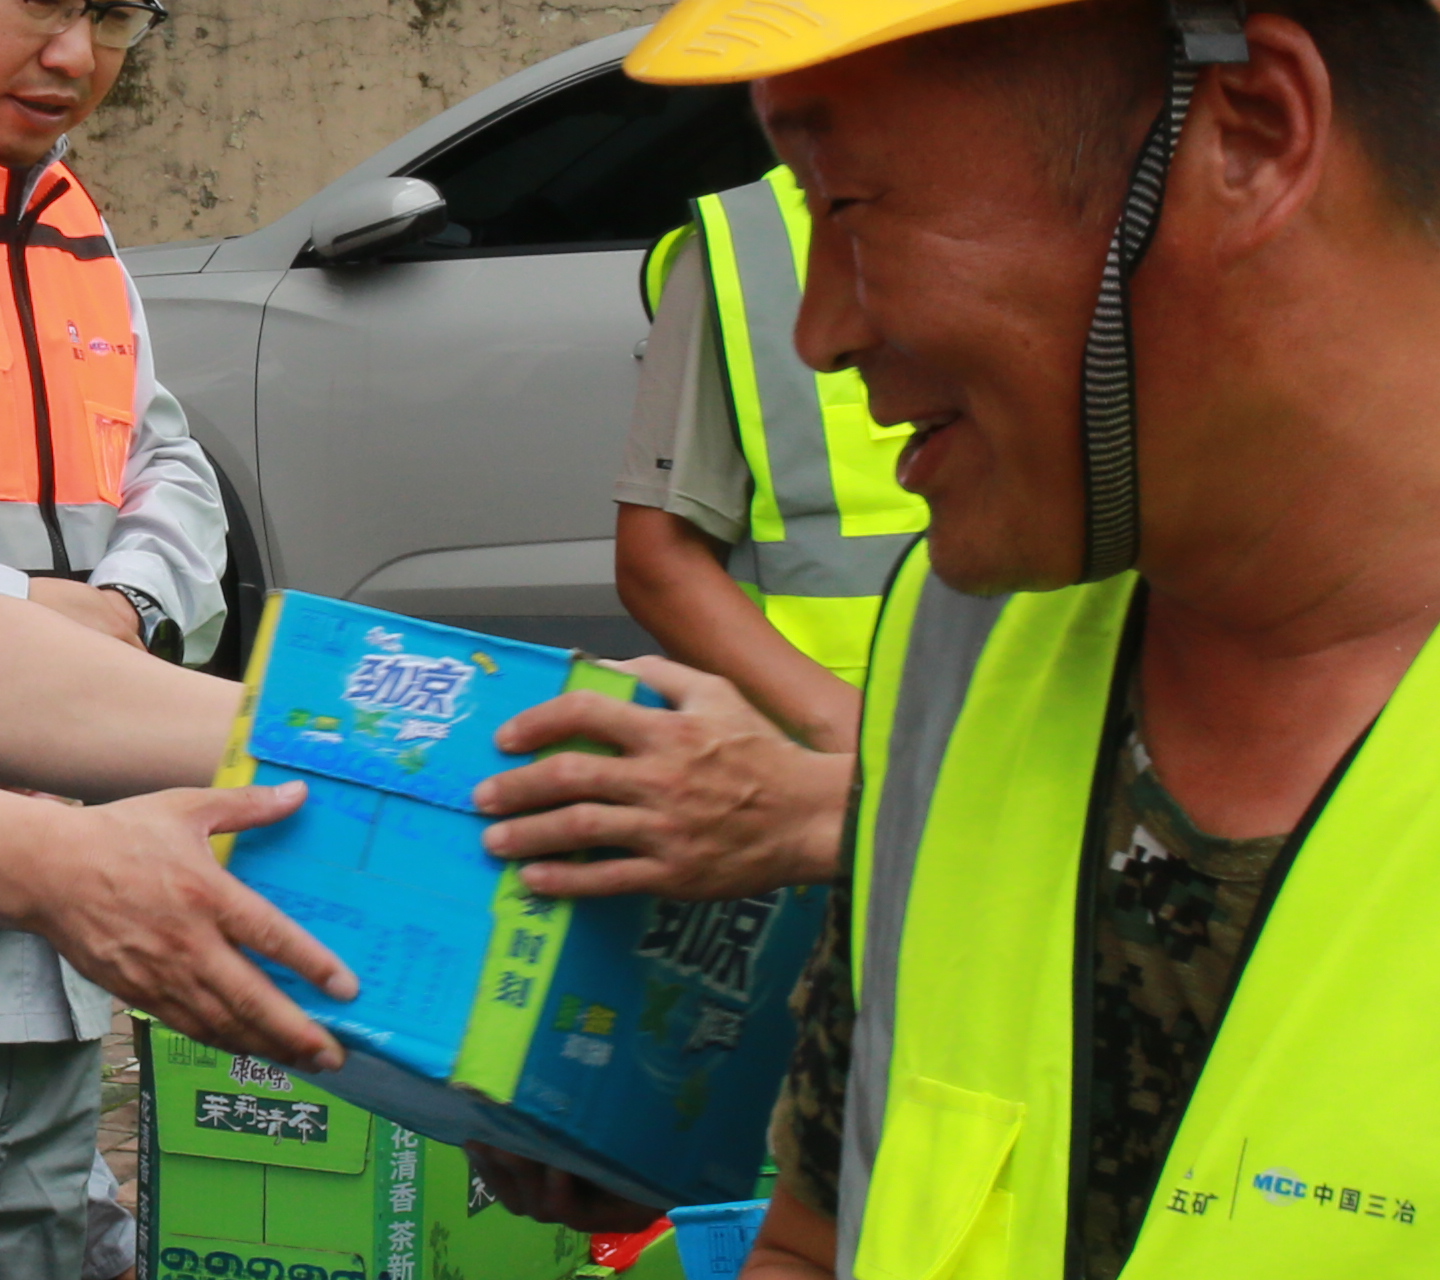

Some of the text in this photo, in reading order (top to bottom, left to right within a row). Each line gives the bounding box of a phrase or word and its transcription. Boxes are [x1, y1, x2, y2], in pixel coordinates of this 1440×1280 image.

[196, 1094, 328, 1144] 茉莉清茶
[1253, 1174, 1416, 1225] MCC 中国三冶
